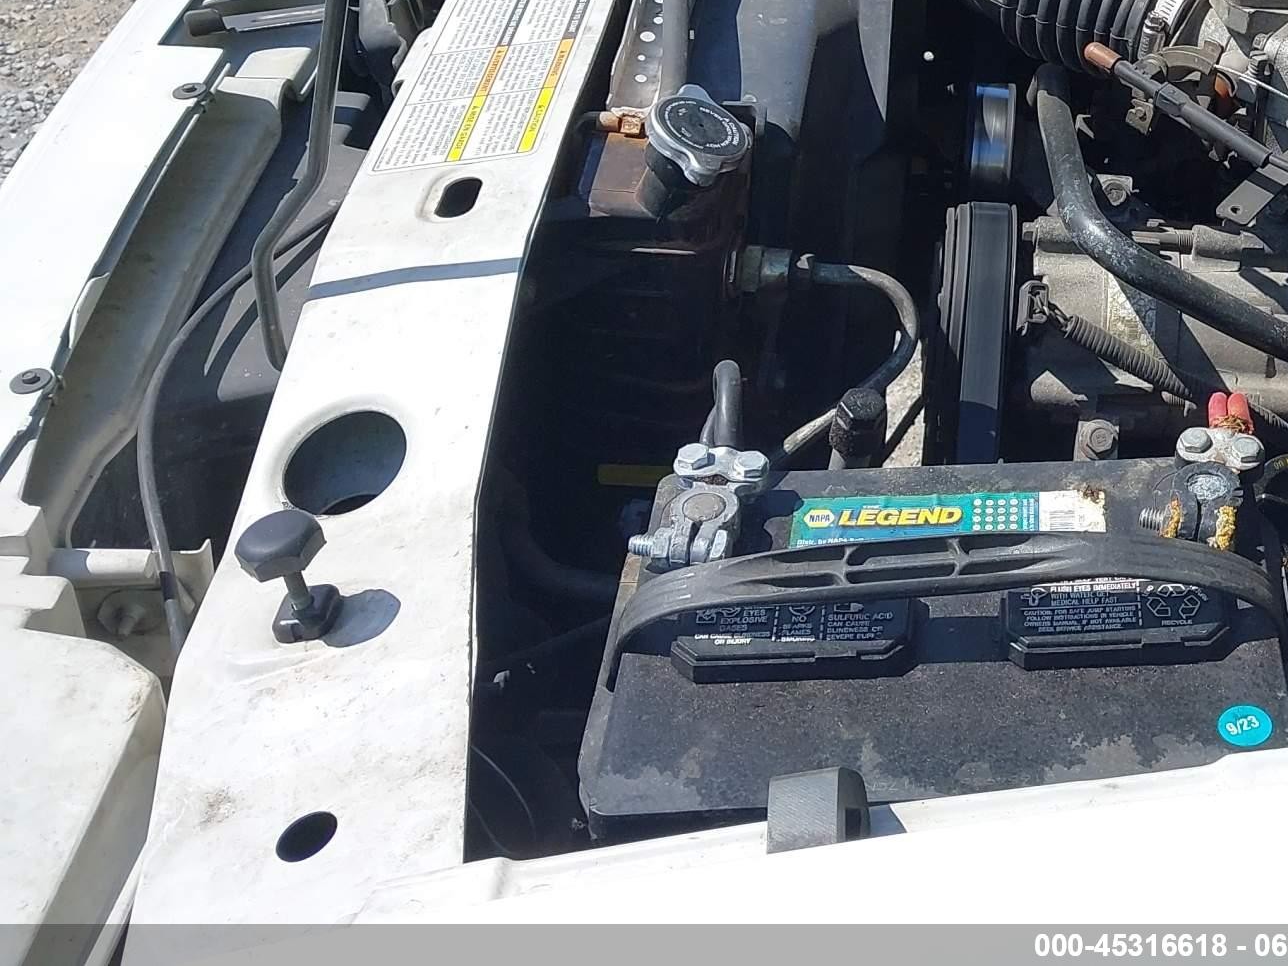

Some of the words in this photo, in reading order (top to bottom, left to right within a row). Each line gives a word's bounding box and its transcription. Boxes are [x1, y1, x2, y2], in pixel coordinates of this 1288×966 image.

[529, 108, 543, 132] CAUTION
[809, 514, 831, 522] NAPA
[838, 506, 964, 527] LEGEND
[1073, 585, 1091, 593] EYES
[1093, 583, 1136, 591] IMMEDIATELY
[743, 609, 766, 617] EYES
[828, 613, 870, 621] SULFURIC
[872, 612, 894, 620] ACID
[720, 616, 768, 625] EXPLOSIVE
[720, 624, 748, 632] GASES
[1225, 715, 1260, 736] 9/23
